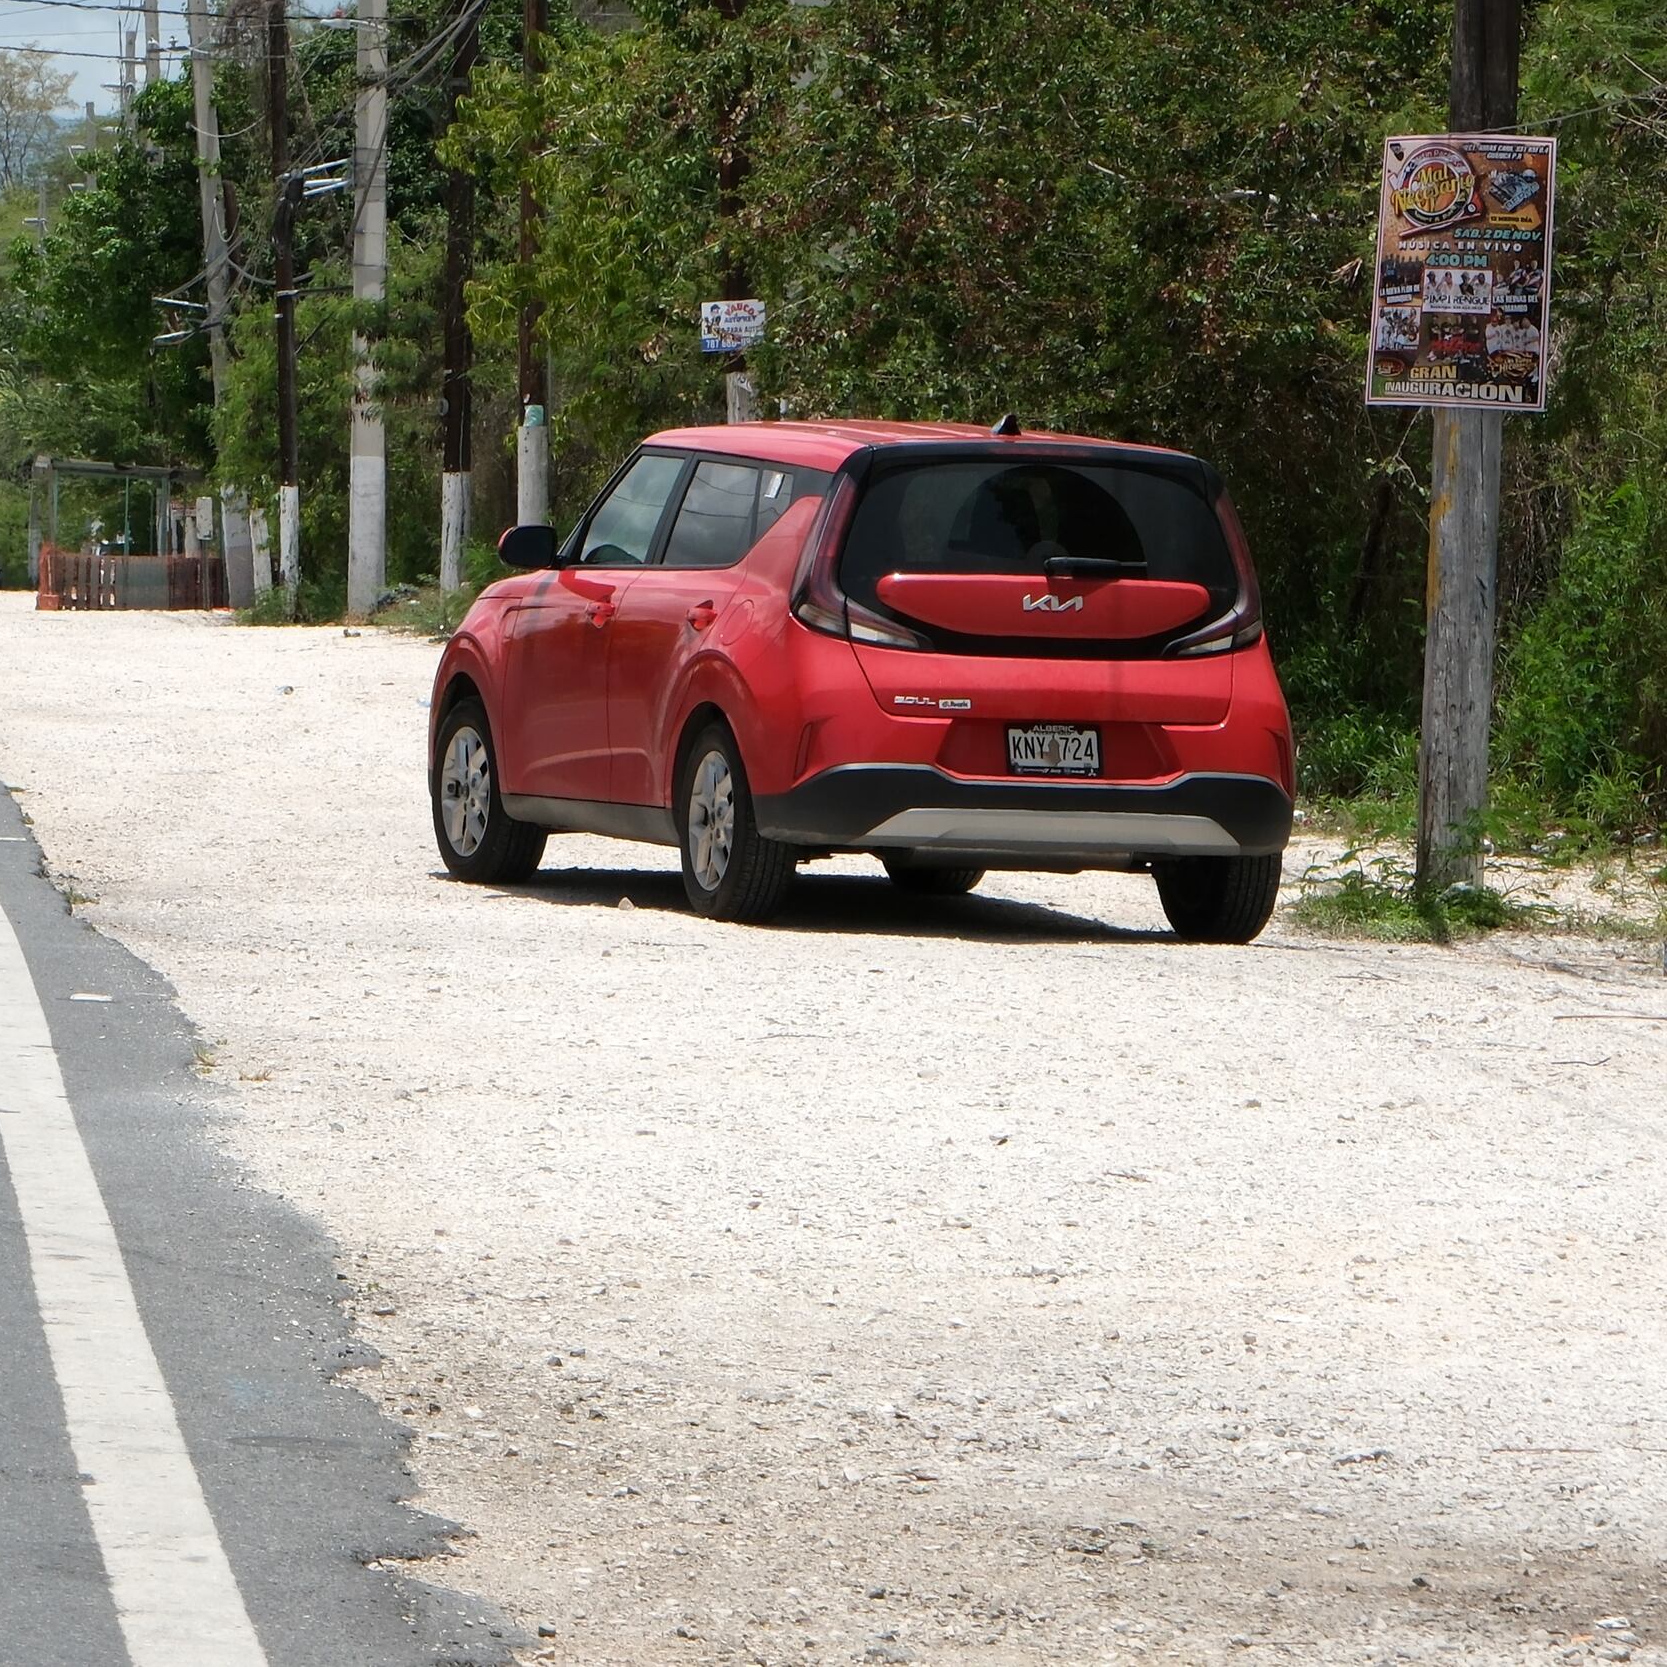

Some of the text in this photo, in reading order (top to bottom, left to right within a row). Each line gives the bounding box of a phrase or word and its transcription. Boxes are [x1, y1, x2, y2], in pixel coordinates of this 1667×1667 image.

[1417, 163, 1448, 184] Mal
[1483, 229, 1493, 239] 2
[1493, 230, 1514, 240] DE
[1515, 230, 1543, 241] NOV.
[1398, 238, 1523, 252] MÚSICA EN VIVO
[1425, 253, 1488, 268] 4:00 PM
[1410, 365, 1457, 379] GRAN
[1384, 380, 1524, 403] INAUGURACIÓN
[1023, 594, 1084, 613] KIA
[894, 695, 936, 705] SOUL
[1033, 724, 1075, 733] ALBERIC
[1012, 736, 1095, 761] KNY 724
